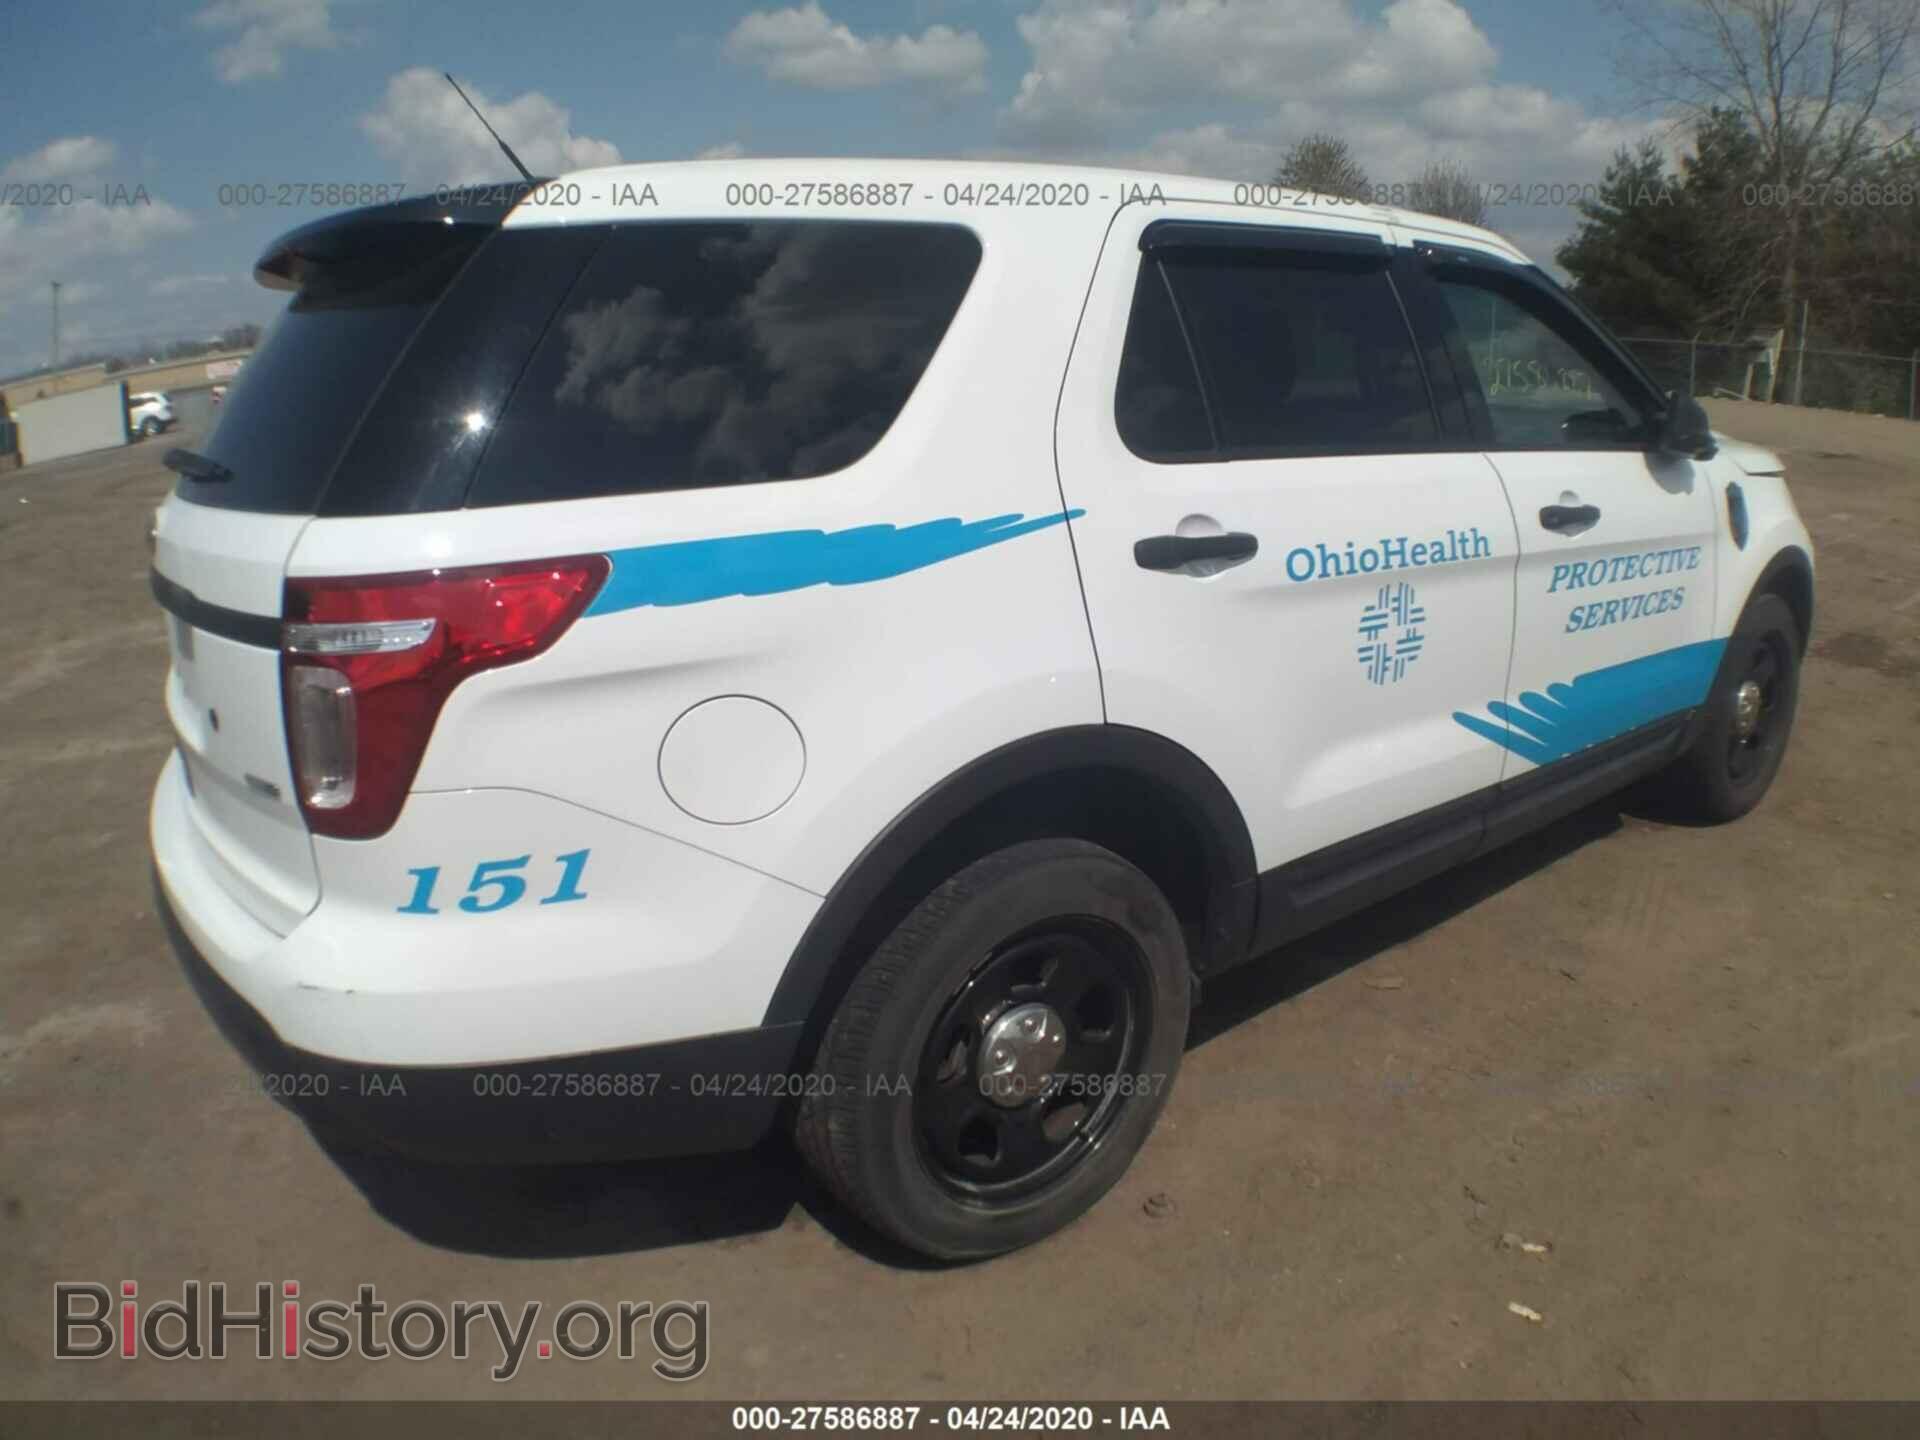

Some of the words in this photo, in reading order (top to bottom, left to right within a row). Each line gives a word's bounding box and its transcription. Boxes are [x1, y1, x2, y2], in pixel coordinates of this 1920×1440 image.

[1286, 527, 1492, 582] OhioHealth
[1546, 546, 1702, 593] PROTECTIVE
[1564, 586, 1686, 634] SERVICES
[396, 848, 592, 914] 151
